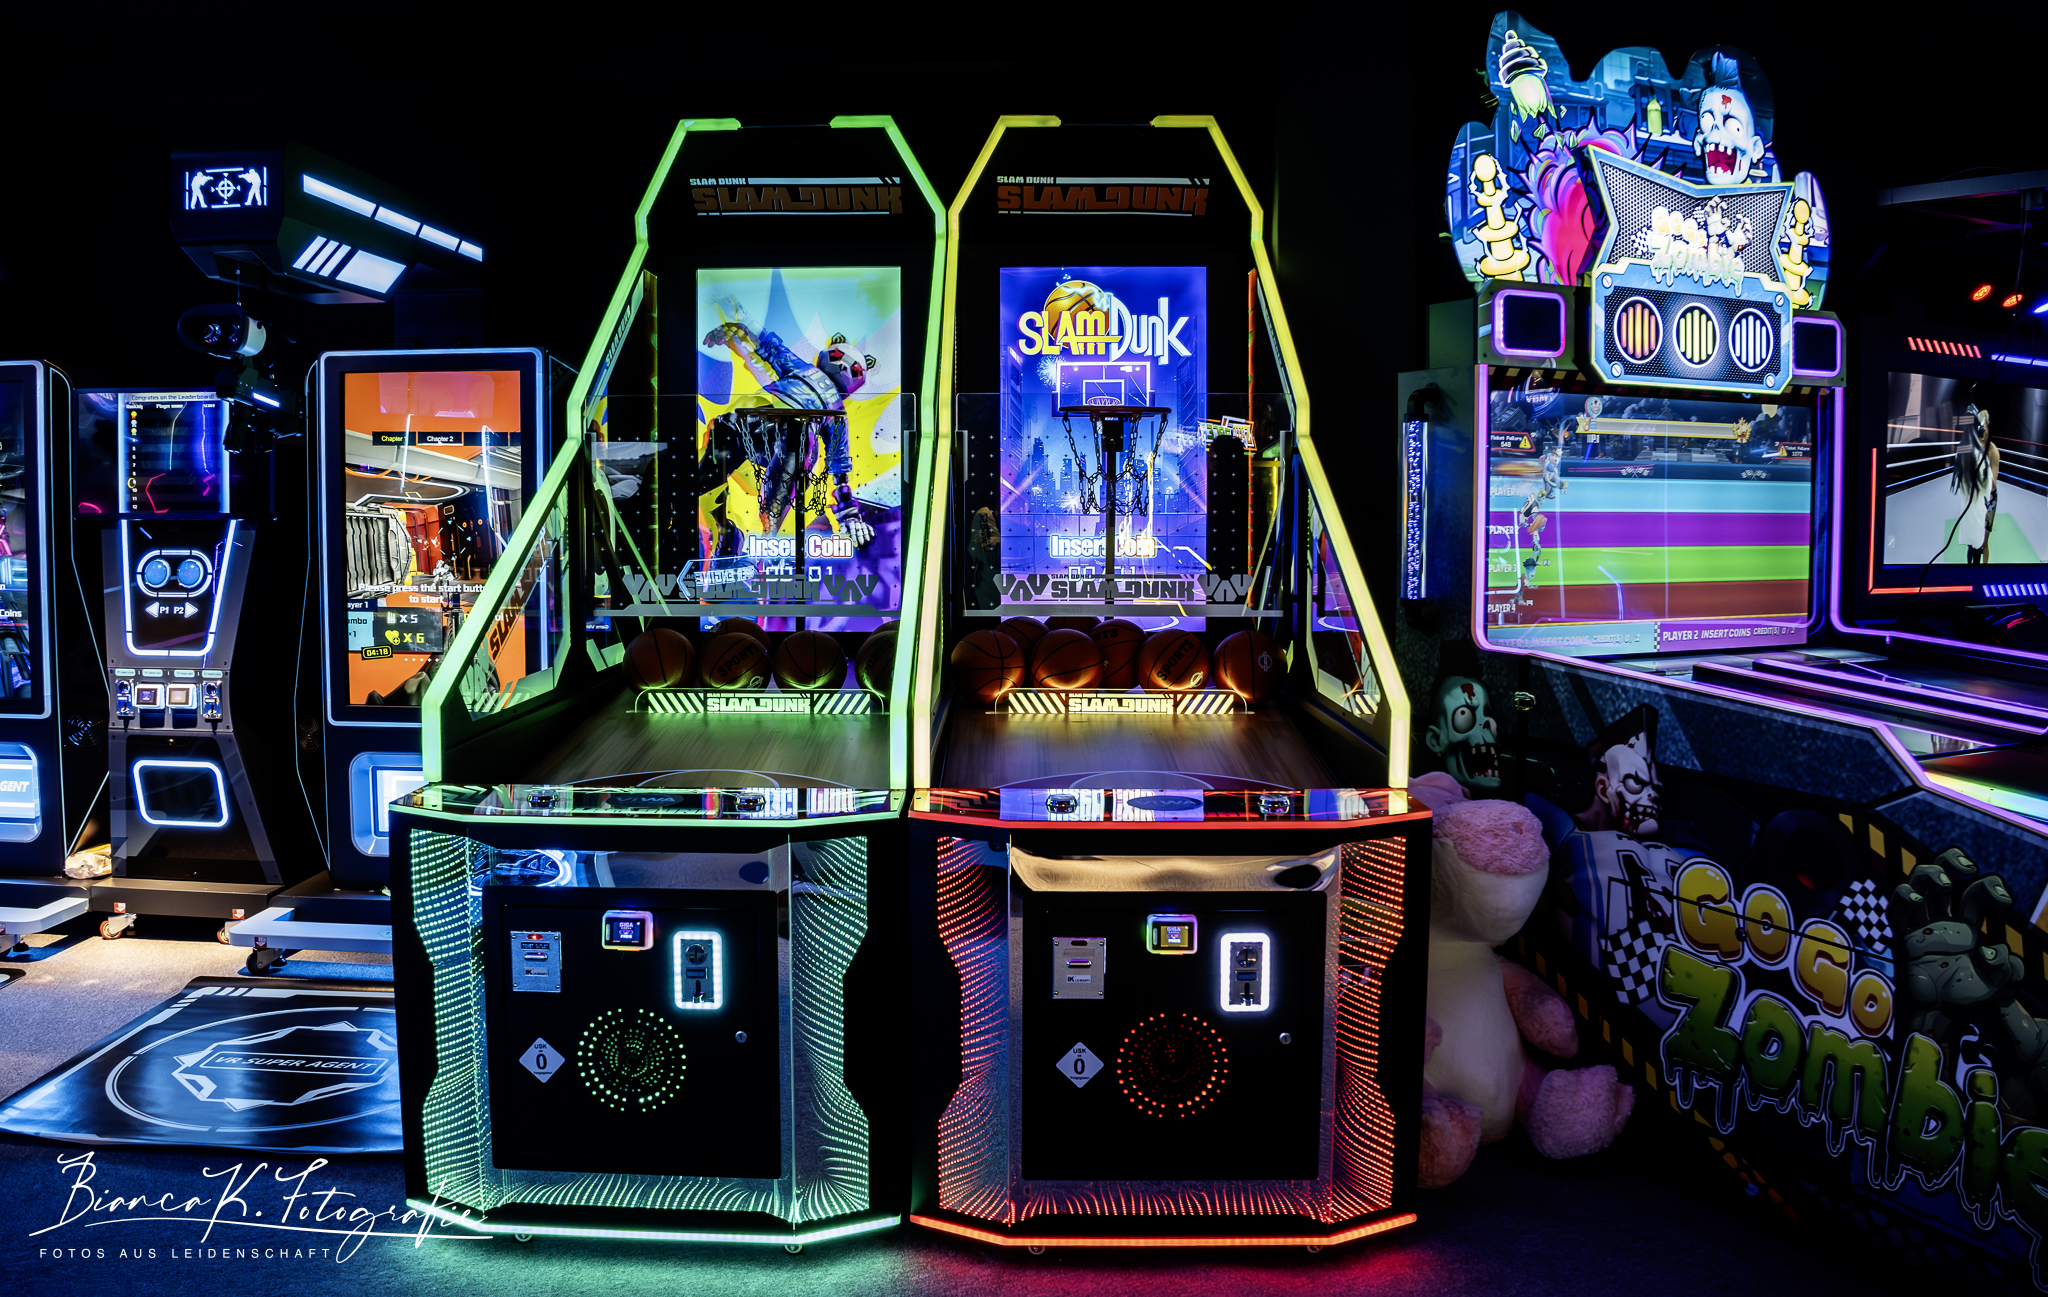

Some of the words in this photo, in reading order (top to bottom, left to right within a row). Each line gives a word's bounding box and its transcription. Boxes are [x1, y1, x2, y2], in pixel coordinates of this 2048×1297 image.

[997, 176, 1024, 184] SLAM
[1026, 176, 1054, 184] DUNK
[1109, 294, 1192, 365] Dunk
[381, 435, 403, 443] Chapter
[427, 435, 449, 443] Chapter
[1490, 525, 1514, 534] PLAYER
[749, 535, 796, 558] Inser
[808, 535, 853, 559] Coin
[1050, 535, 1106, 558] Insert
[1489, 564, 1510, 573] PLAYER
[358, 584, 390, 592] Please
[393, 584, 418, 594] press
[420, 584, 437, 592] the
[438, 584, 462, 592] start
[463, 584, 484, 592] butt
[1051, 581, 1119, 598] SLAM
[1125, 581, 1194, 601] DUNK
[0, 609, 22, 617] Coins
[1488, 603, 1510, 613] PLAYER
[411, 614, 418, 623] 5
[416, 632, 425, 643] 6
[1663, 630, 1692, 641] PLAYER
[1694, 630, 1698, 640] 2
[1701, 629, 1728, 639] INSERT
[1729, 628, 1751, 638] COINS
[1753, 627, 1780, 636] CREDIT(S)
[1563, 635, 1589, 646] COINS
[366, 648, 389, 657] 04:18
[717, 642, 760, 678] SPORTS
[1156, 638, 1195, 682] SPORTS
[707, 698, 757, 711] SLAM
[760, 698, 811, 714] DUNK
[1069, 698, 1119, 711] SLAM
[1122, 698, 1174, 714] DUNK
[215, 1056, 243, 1064] VR
[242, 1057, 307, 1067] SUPER
[304, 1060, 377, 1070] AGENT
[536, 1053, 547, 1070] 0
[1074, 1058, 1085, 1075] 0
